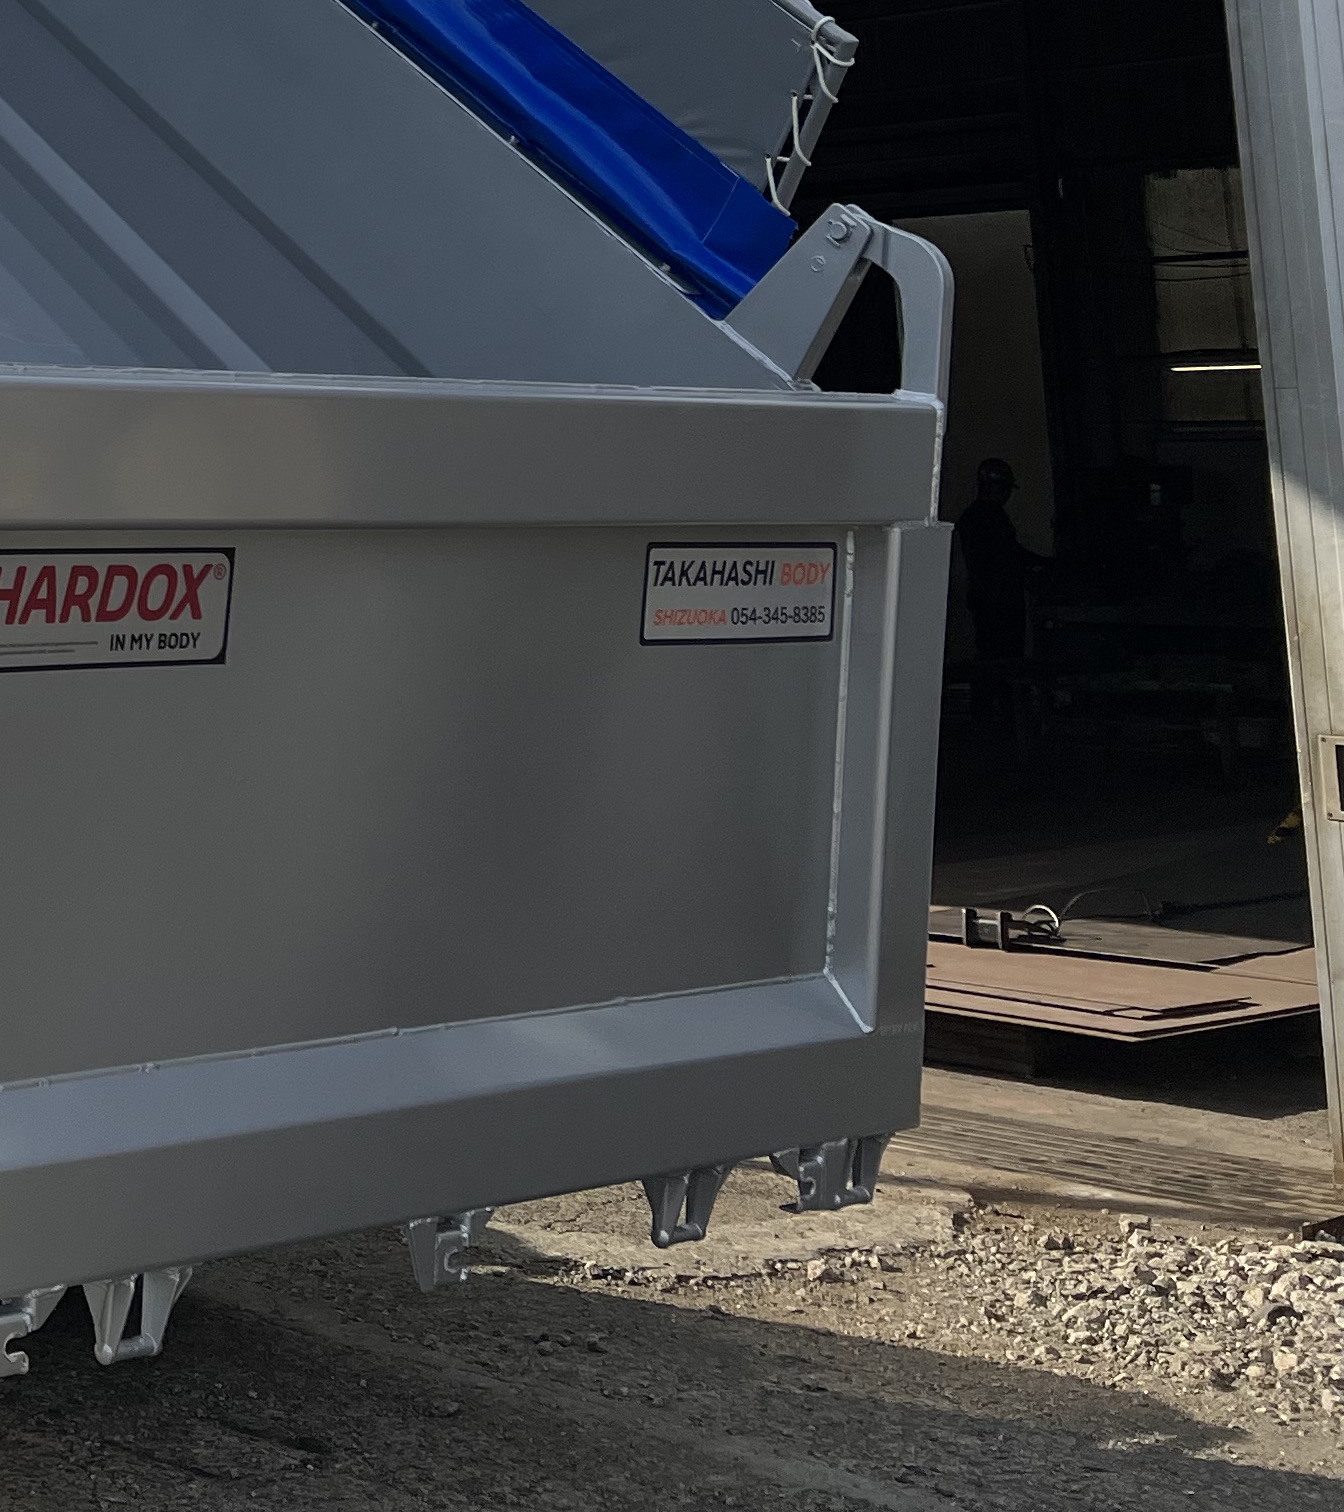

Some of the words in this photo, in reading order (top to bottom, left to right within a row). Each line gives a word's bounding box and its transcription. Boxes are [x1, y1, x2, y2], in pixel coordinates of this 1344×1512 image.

[652, 560, 775, 587] TAKAHASHI
[780, 562, 832, 586] BODY
[652, 608, 727, 626] SHIZUOKA
[731, 605, 825, 626] 054-345-8385
[109, 634, 125, 652] IN
[130, 633, 154, 651] MY
[158, 632, 201, 650] BODY
